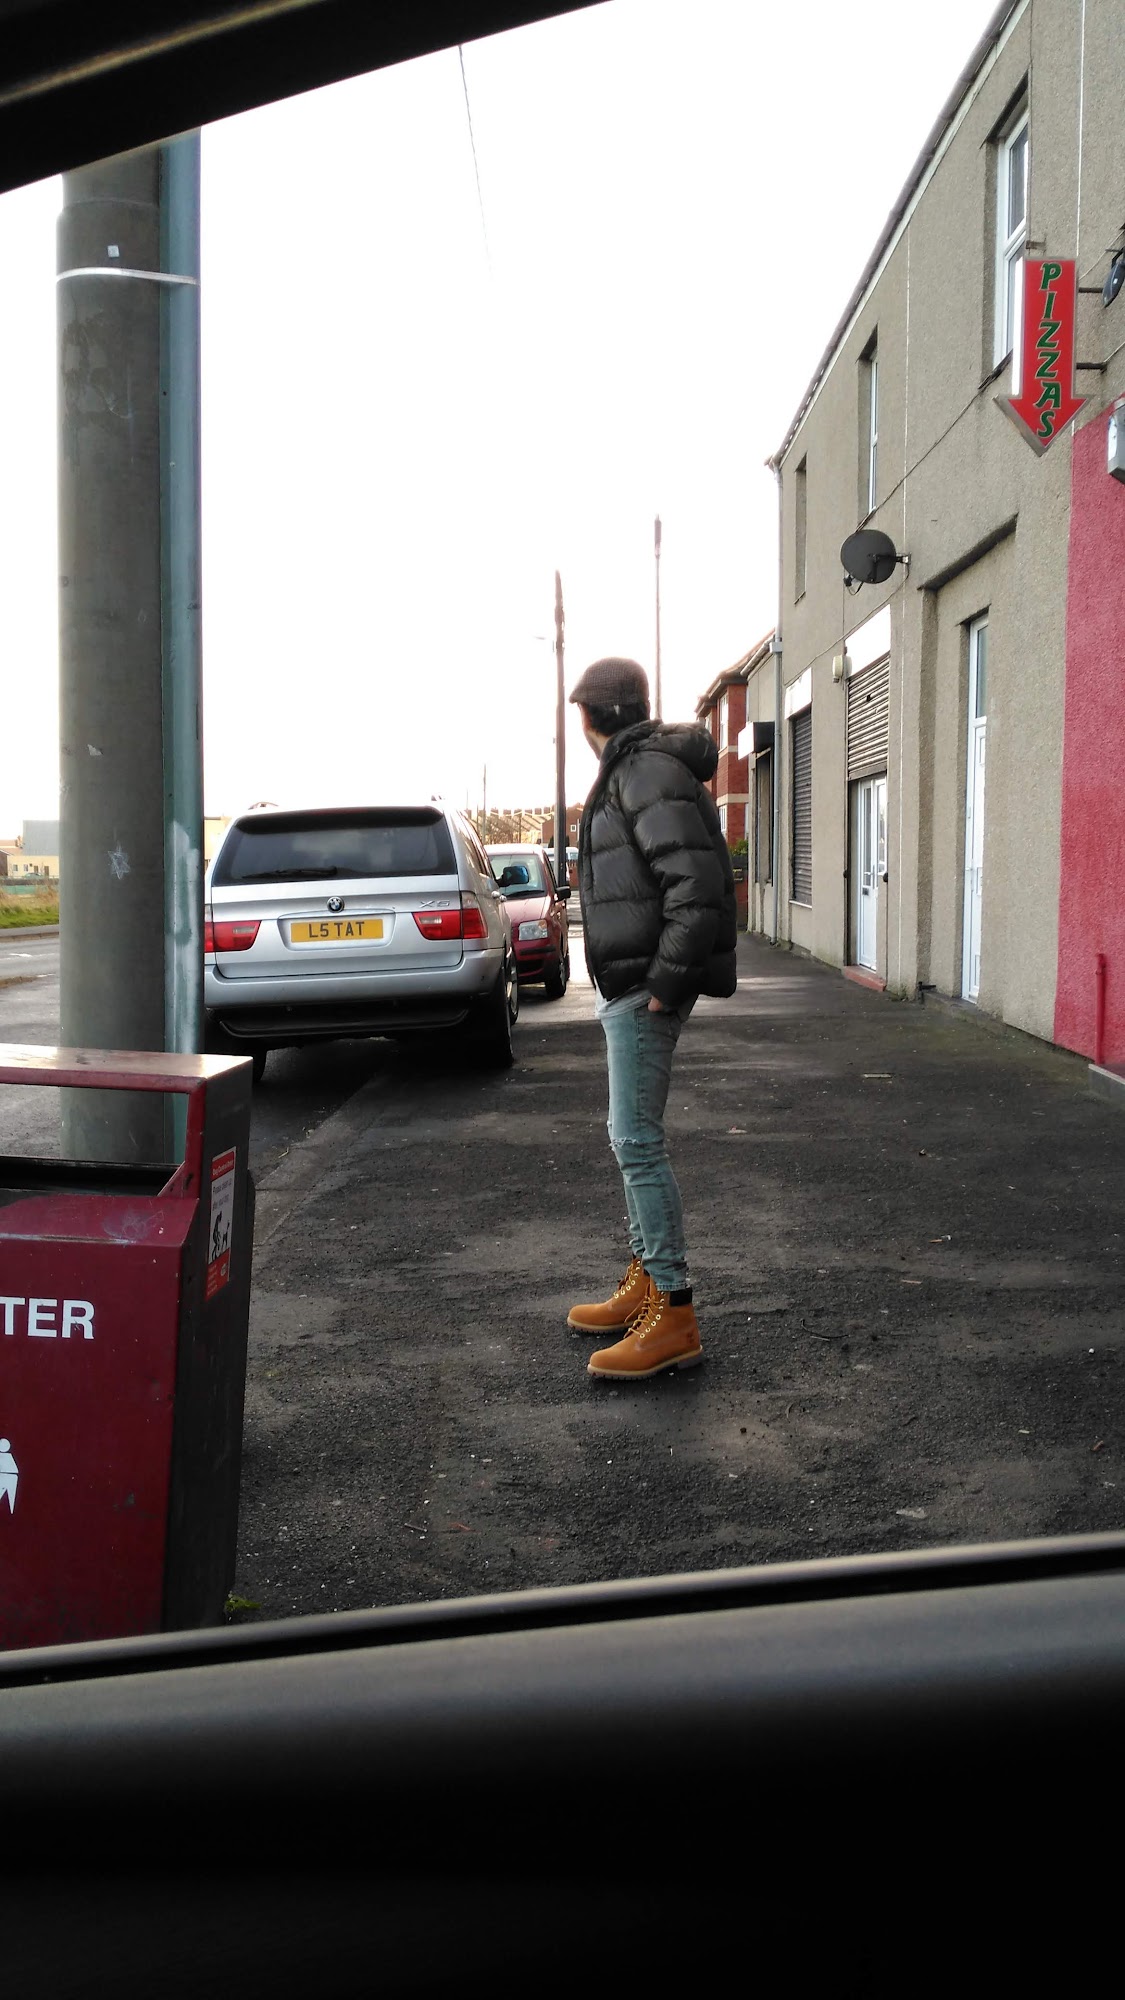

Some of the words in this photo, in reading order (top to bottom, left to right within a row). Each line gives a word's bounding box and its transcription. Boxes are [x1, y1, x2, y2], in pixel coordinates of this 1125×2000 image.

[1034, 262, 1062, 438] PIZZAS
[308, 923, 329, 938] L5
[334, 921, 365, 937] TAT
